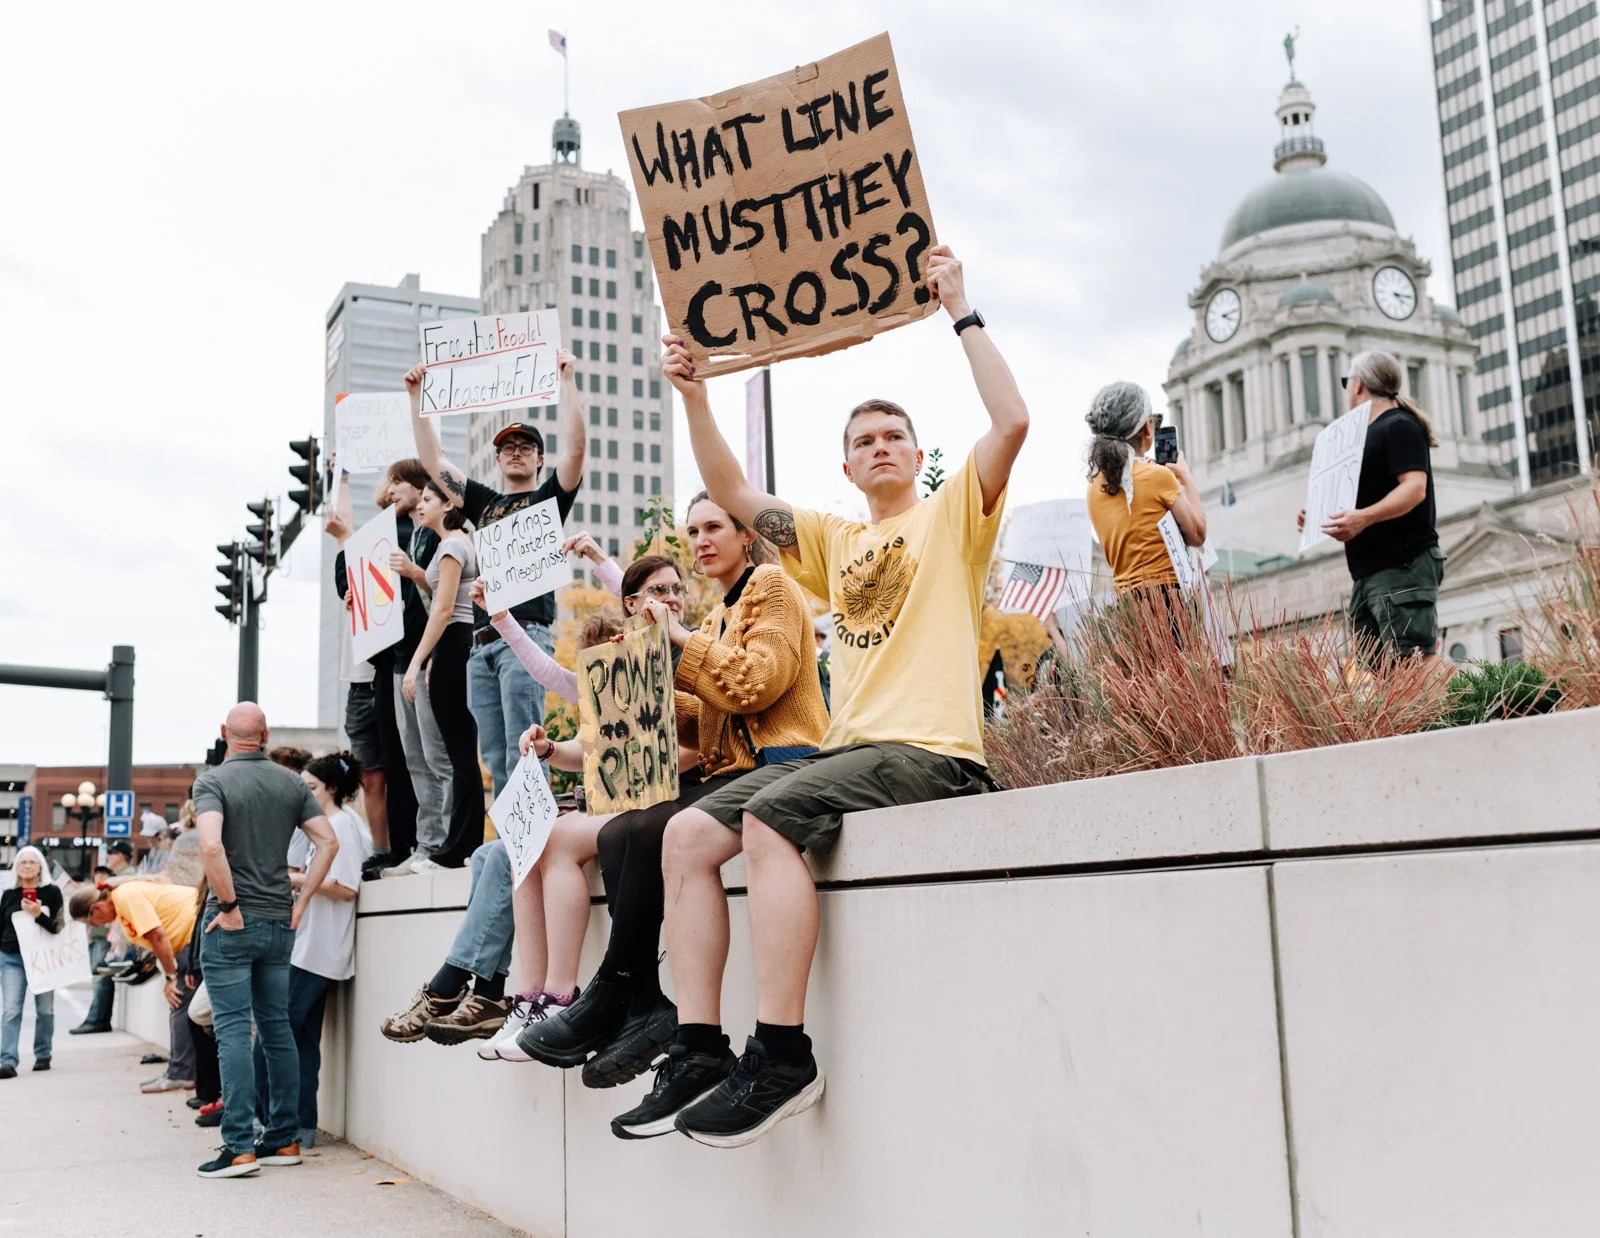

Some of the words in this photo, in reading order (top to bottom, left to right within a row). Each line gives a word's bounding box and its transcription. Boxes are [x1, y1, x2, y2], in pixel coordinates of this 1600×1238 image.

[632, 112, 765, 189] WHAT
[781, 68, 894, 154] LINE
[682, 211, 931, 349] CROSS?
[424, 325, 463, 365] Free
[421, 367, 486, 412] Release
[110, 793, 129, 819] H
